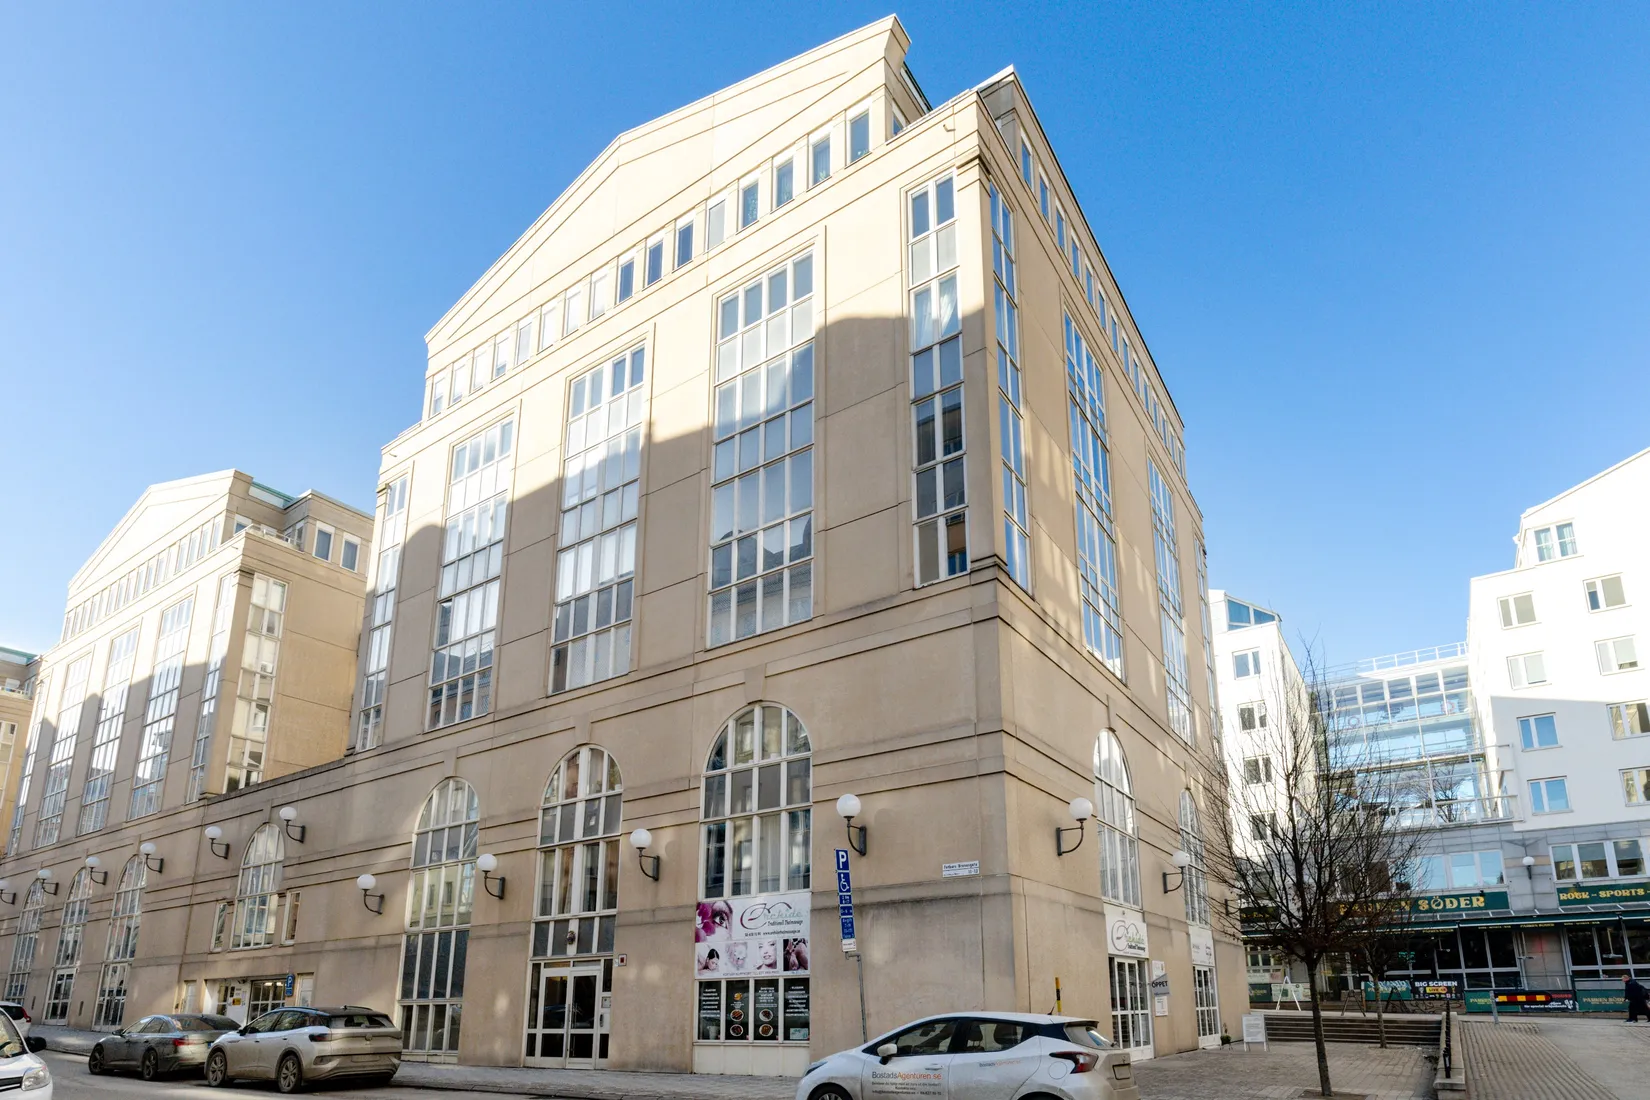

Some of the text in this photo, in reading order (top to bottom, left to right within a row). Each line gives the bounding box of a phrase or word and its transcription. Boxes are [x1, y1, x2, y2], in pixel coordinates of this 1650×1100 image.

[838, 851, 847, 869] P
[1559, 890, 1590, 901] ROCK
[1598, 888, 1645, 898] SPORTS
[1417, 896, 1485, 911] SÖDER
[287, 976, 293, 988] P
[1151, 980, 1168, 989] ÖPPET
